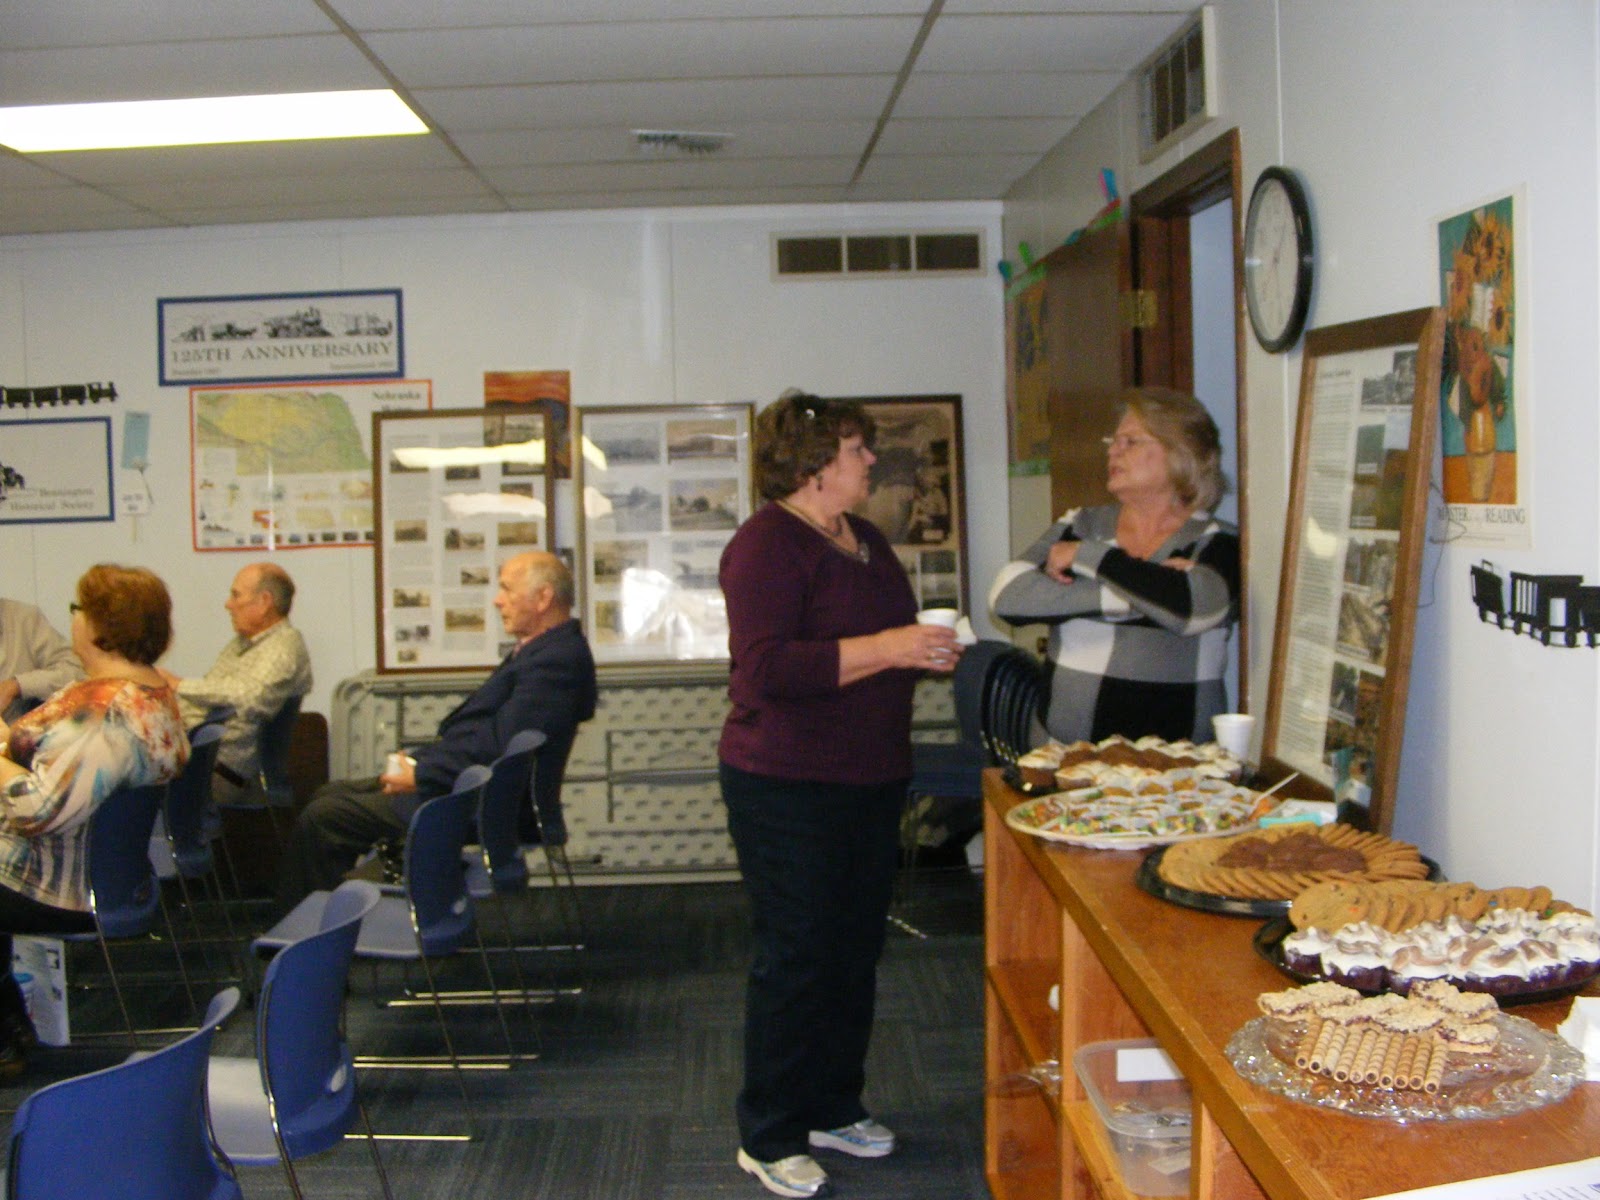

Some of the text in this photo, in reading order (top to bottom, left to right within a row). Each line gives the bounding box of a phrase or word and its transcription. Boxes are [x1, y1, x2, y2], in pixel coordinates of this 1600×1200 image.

[172, 341, 392, 363] 125TH ANNIVERSARY
[1486, 507, 1526, 524] READING
